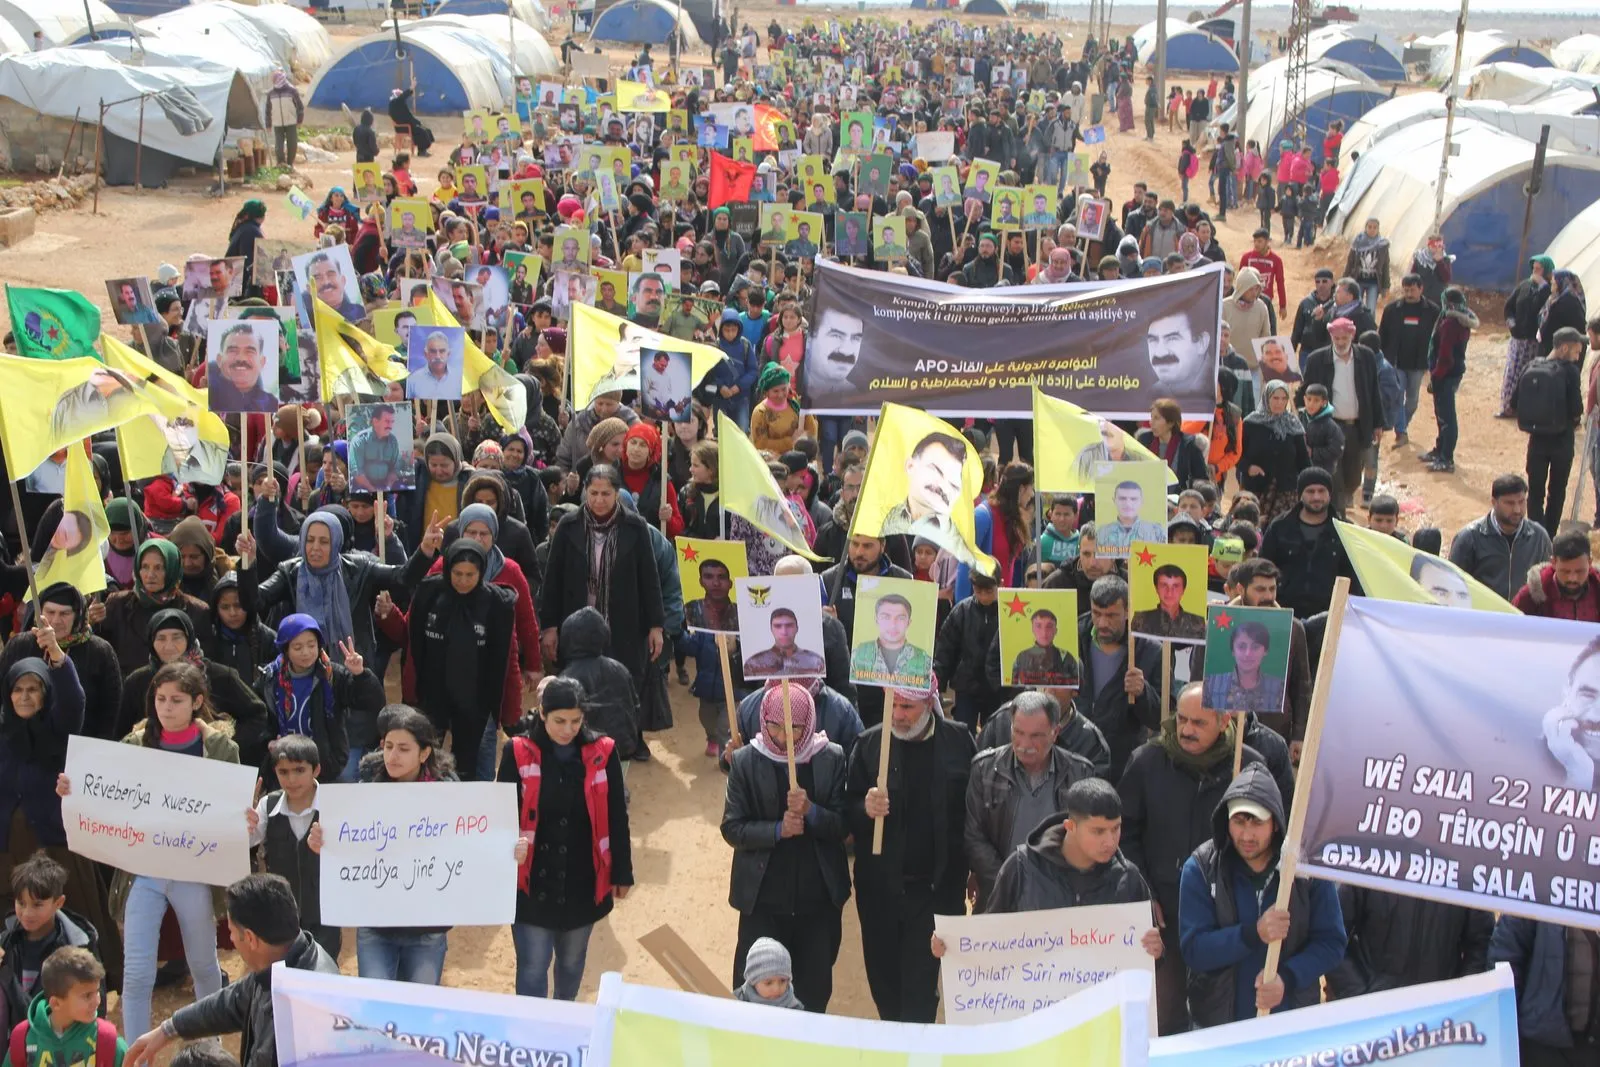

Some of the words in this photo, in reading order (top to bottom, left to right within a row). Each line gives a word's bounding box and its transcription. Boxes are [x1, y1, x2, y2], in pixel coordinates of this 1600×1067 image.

[873, 305, 931, 322] komployek
[933, 311, 941, 321] li
[1124, 309, 1137, 322] ye
[914, 359, 948, 372] APO
[951, 361, 983, 374] القائد
[985, 362, 1005, 374] على
[1048, 356, 1097, 371] المؤامرة
[869, 377, 908, 391] السلام
[1075, 375, 1096, 390] على
[1098, 374, 1140, 390] مؤامرة
[1364, 753, 1405, 792] WÊ
[1412, 766, 1473, 802] SALA
[1488, 776, 1530, 809] 22
[1543, 785, 1598, 821] YAN
[161, 792, 211, 816] xweser
[152, 830, 196, 850] civakê
[194, 840, 218, 858] ye
[338, 819, 398, 852] Azadîya
[408, 815, 449, 839] rêber
[455, 814, 489, 836] APO
[1385, 806, 1422, 839] BO
[1438, 807, 1545, 861] TÊKOŞÎN
[1556, 823, 1576, 862] Û
[339, 855, 399, 890] azadîya
[402, 855, 437, 892] jinê
[435, 858, 465, 892] ye
[1321, 842, 1402, 878] GELAN
[1472, 863, 1537, 902] SALA
[1122, 925, 1137, 947] û
[453, 1030, 571, 1067] Netewa
[1341, 1017, 1486, 1065] avakirin.
